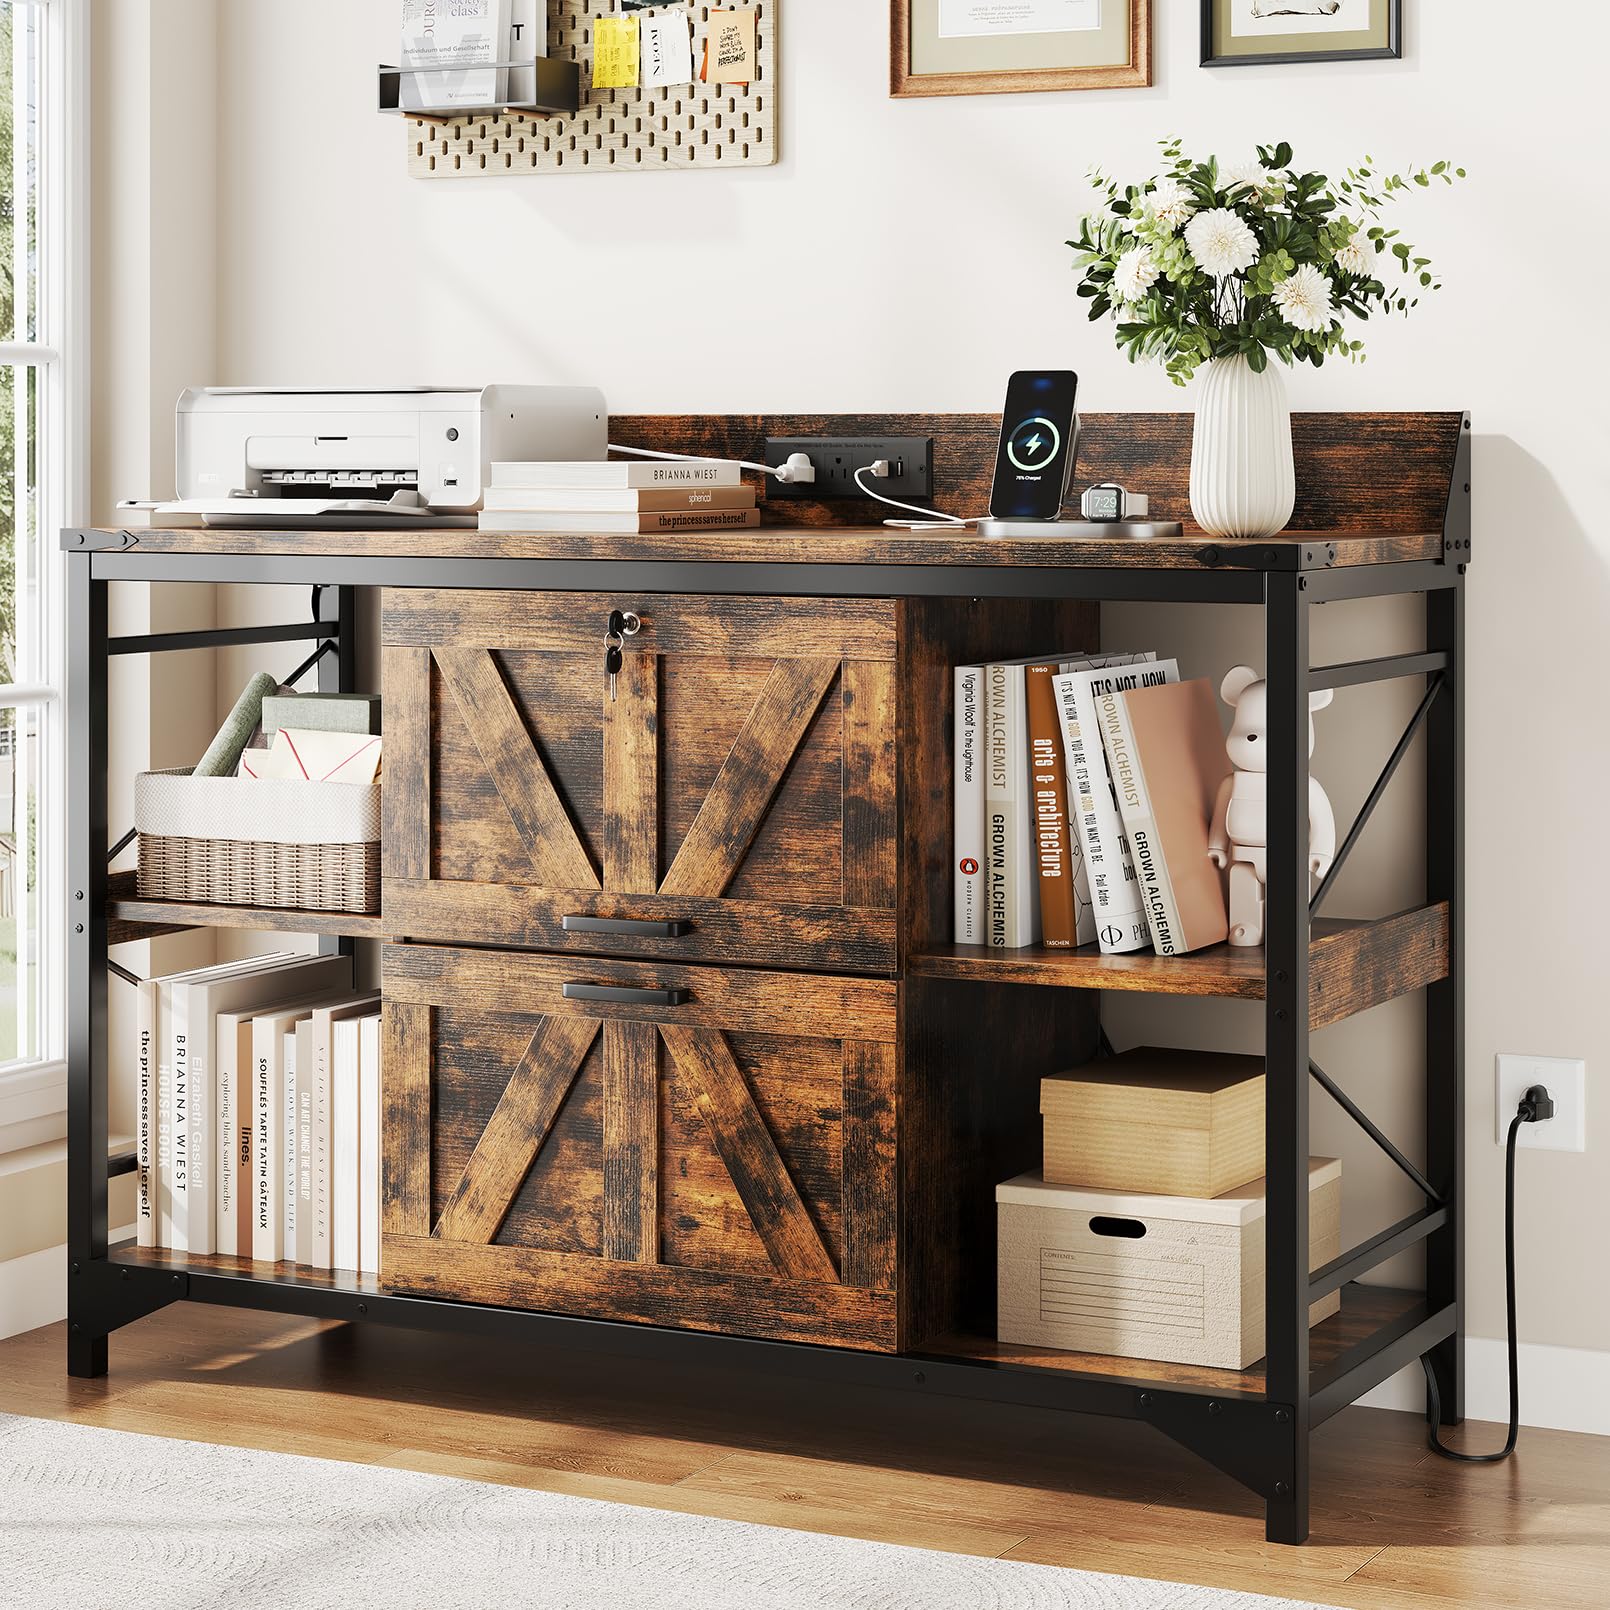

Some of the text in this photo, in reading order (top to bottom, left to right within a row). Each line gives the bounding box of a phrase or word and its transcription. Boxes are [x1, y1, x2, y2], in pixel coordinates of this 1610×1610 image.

[451, 5, 478, 16] class
[512, 24, 524, 40] T
[653, 469, 718, 481] BRIANNA WIEST
[1094, 496, 1117, 508] 7:29
[962, 673, 976, 703] Virginia
[1060, 680, 1073, 692] IT'S
[1063, 693, 1075, 707] NOT
[1065, 707, 1078, 720] HOW
[965, 704, 976, 727] Woolf
[965, 738, 974, 748] the
[992, 712, 1006, 788] ALCHEMIST
[1034, 739, 1056, 766] arts
[1071, 738, 1084, 751] YOU
[962, 748, 974, 782] Lighthouse
[1076, 767, 1088, 780] IT'S
[1112, 737, 1140, 808] ALCHEMIST
[1079, 781, 1091, 794] HOW
[1085, 812, 1096, 826] YOU
[1037, 790, 1063, 877] architecture
[1086, 826, 1100, 844] WANT
[1090, 844, 1102, 855] TO
[992, 814, 1005, 948] GROWN ALCHEMIS
[1095, 873, 1110, 907] Paul Arden
[1135, 831, 1176, 956] GROWN ALCHEMIS
[221, 1072, 231, 1119] exploring
[260, 1058, 268, 1108] SOUFFLÉS
[159, 1064, 170, 1169] HOUSE BOOK
[176, 1035, 186, 1191] BRIANNA WIEST
[192, 1056, 203, 1188] Elizabeth Gaskell
[223, 1121, 231, 1147] black
[242, 1126, 252, 1167] lines.
[300, 1092, 310, 1200] CAN ART CHANGE THE WORLD?
[260, 1180, 269, 1229] GÂTEAUX
